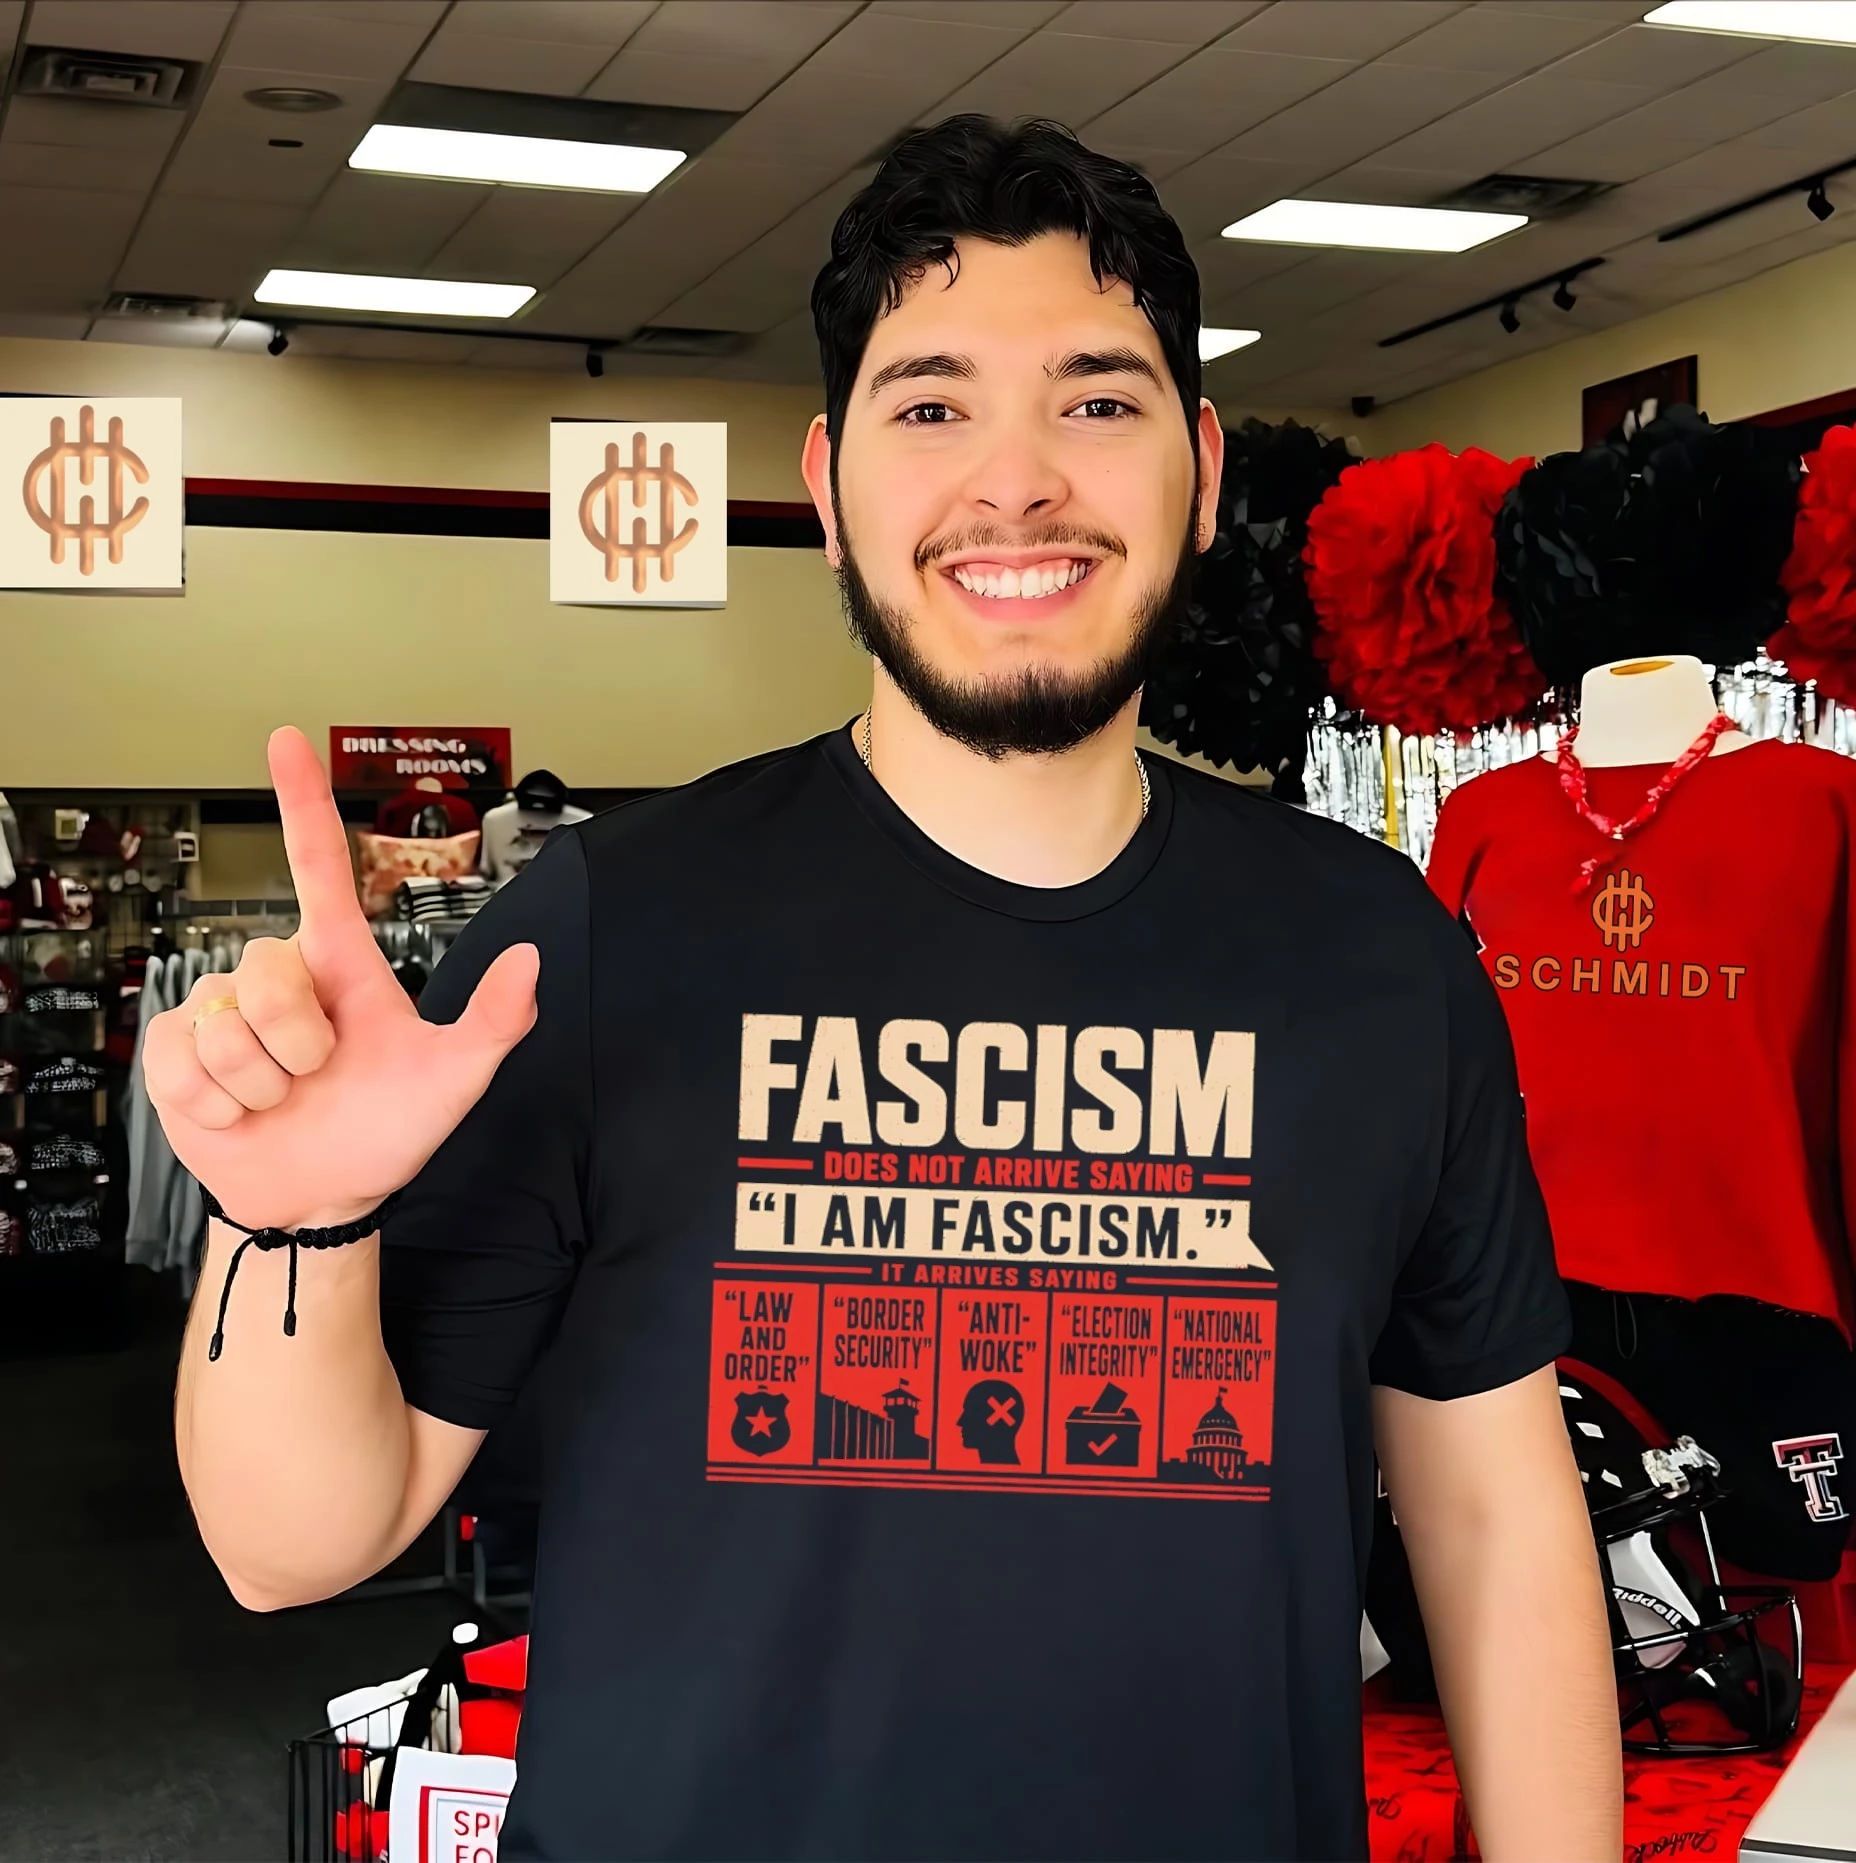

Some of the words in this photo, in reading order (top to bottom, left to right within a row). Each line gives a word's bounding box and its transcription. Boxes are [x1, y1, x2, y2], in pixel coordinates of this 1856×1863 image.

[396, 758, 487, 775] ROOMS
[1494, 954, 1747, 1000] SCHMIDT
[738, 1012, 1257, 1159] FASCISM
[824, 1151, 899, 1183] DOES
[908, 1154, 966, 1186] NOT
[974, 1157, 1080, 1189] ARRIVE
[1090, 1160, 1194, 1193] SAYING
[820, 1194, 907, 1250] AM
[881, 1263, 901, 1282] IT
[913, 1264, 1019, 1288] ARRIVES
[1029, 1267, 1118, 1290] SAYING
[724, 1290, 794, 1323] “LAW
[834, 1296, 926, 1332] “BORDER
[958, 1301, 1031, 1335] “ANTI-
[1061, 1304, 1153, 1340] “ELECTION
[740, 1326, 787, 1351] AND
[1173, 1308, 1262, 1345] “NATIONAL
[724, 1352, 810, 1383] ORDER”
[834, 1334, 932, 1370] SECURITY”
[959, 1338, 1037, 1373] WOKE”
[1059, 1342, 1159, 1378] INTEGRITY”
[1171, 1346, 1272, 1382] EMERGENCY”
